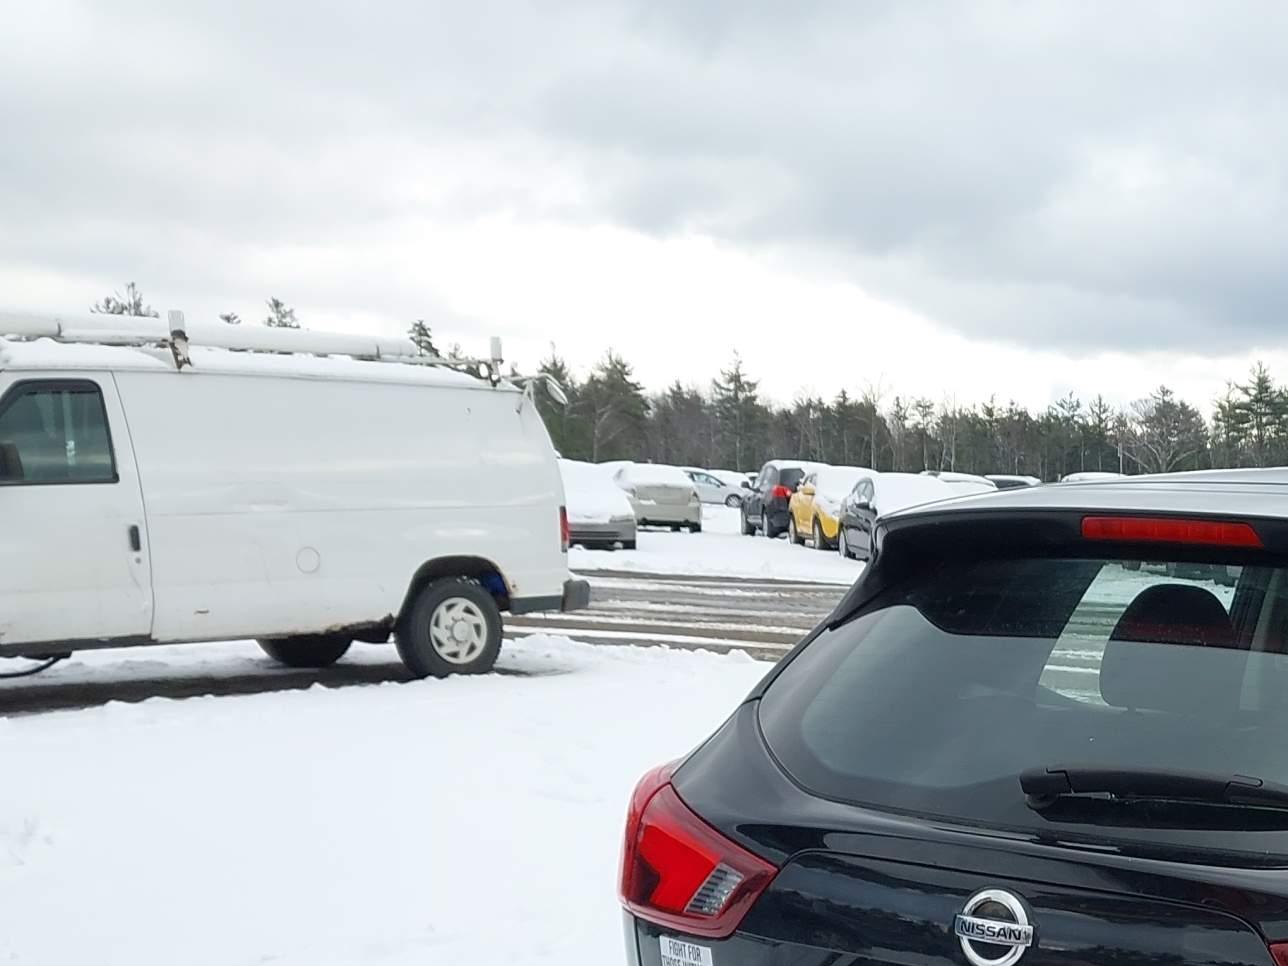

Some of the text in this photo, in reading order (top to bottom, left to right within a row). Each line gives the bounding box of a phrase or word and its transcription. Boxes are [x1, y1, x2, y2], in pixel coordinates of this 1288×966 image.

[960, 920, 1023, 941] NISSAN
[669, 940, 702, 962] FIGHT FOR
